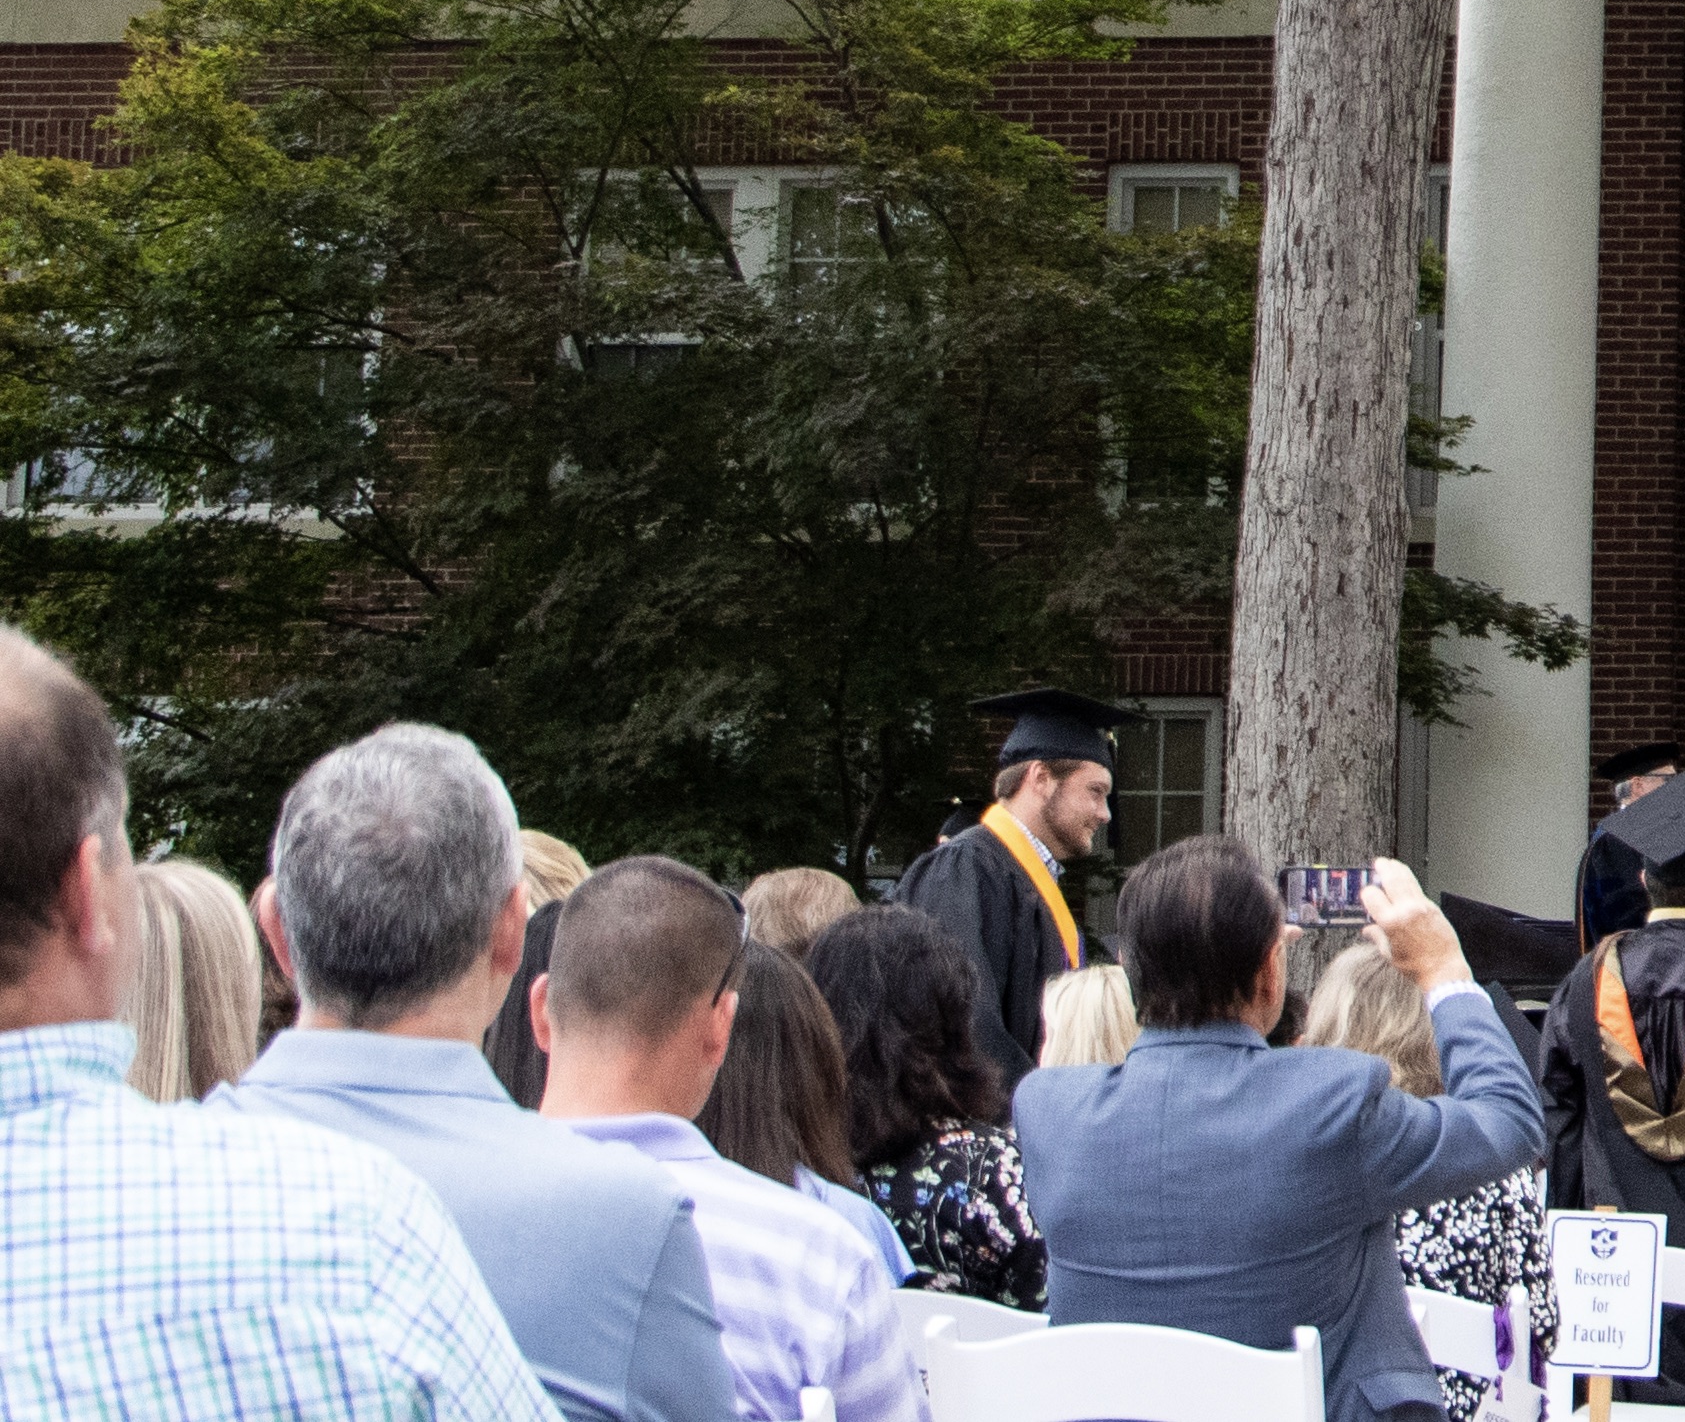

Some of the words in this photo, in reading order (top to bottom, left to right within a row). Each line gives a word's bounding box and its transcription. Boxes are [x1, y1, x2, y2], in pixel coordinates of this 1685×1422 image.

[1575, 1267, 1630, 1287] Reserved
[1592, 1297, 1610, 1313] for
[1573, 1324, 1626, 1349] Faculty
